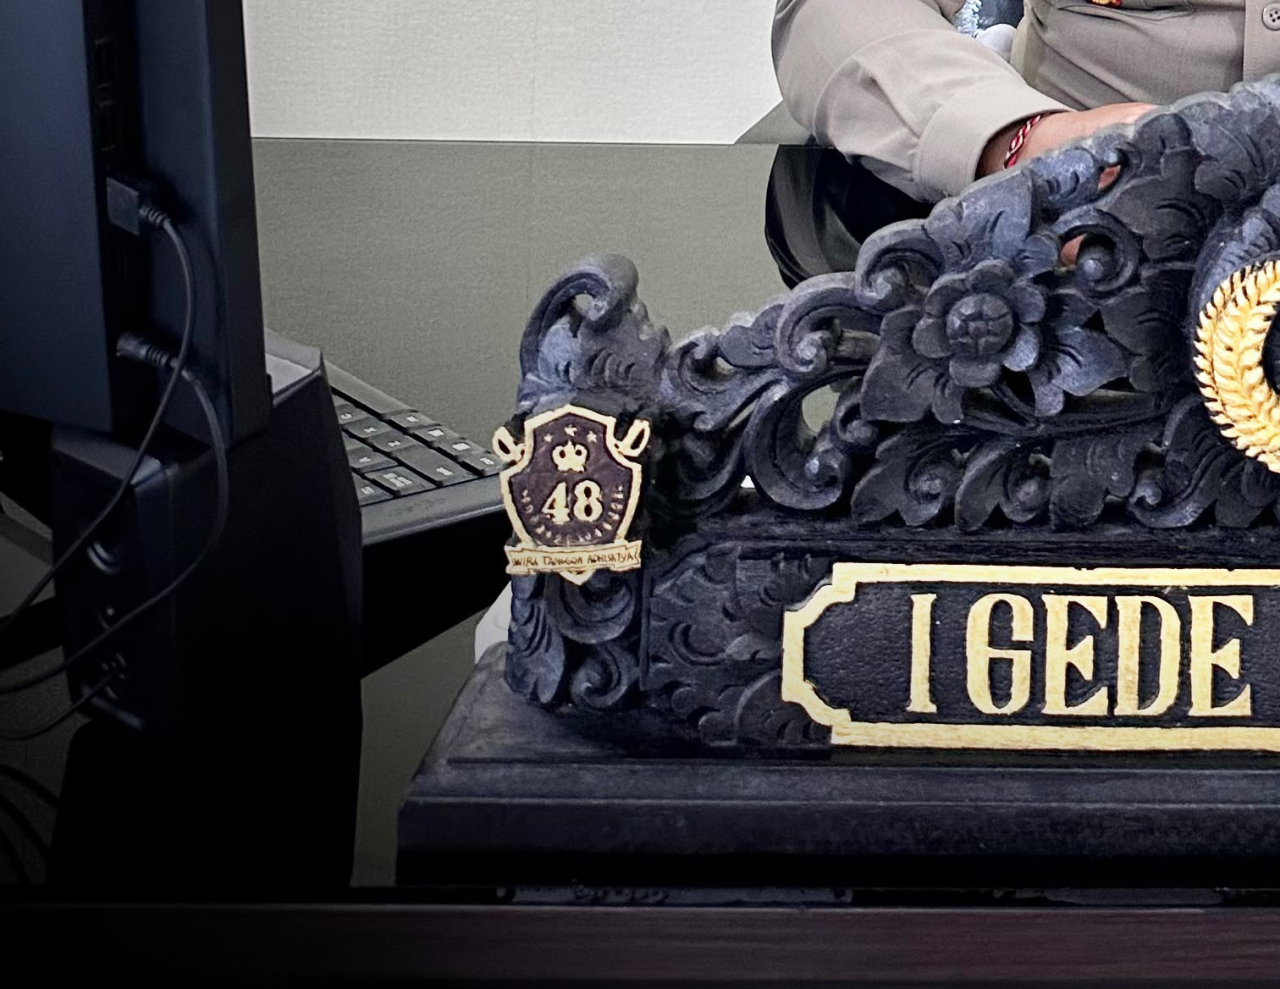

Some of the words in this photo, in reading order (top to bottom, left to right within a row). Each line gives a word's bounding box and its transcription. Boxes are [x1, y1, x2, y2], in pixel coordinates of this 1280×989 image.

[541, 480, 603, 525] 48
[905, 593, 938, 713] I
[965, 592, 1255, 717] GEDE
